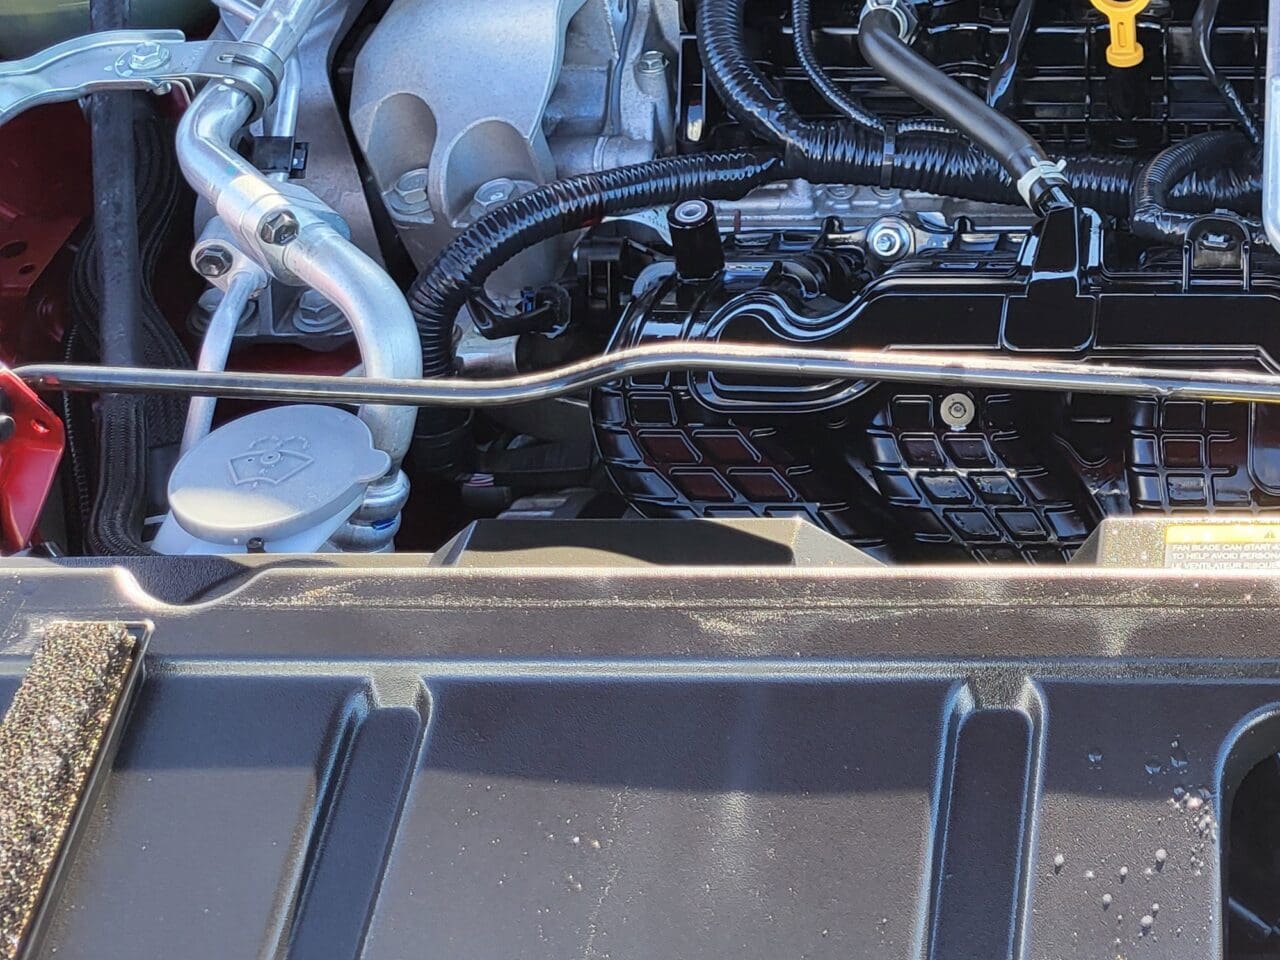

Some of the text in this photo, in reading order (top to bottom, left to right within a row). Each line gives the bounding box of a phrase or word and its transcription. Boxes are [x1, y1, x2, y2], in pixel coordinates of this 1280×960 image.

[1173, 543, 1189, 552] FAN
[1191, 543, 1220, 552] BLADE
[1223, 543, 1241, 552] CAN
[1244, 543, 1271, 552] START
[1173, 552, 1184, 560] TO
[1186, 552, 1210, 560] HELP
[1211, 552, 1238, 560] AVOID
[1184, 560, 1242, 570] VENTILATEUR
